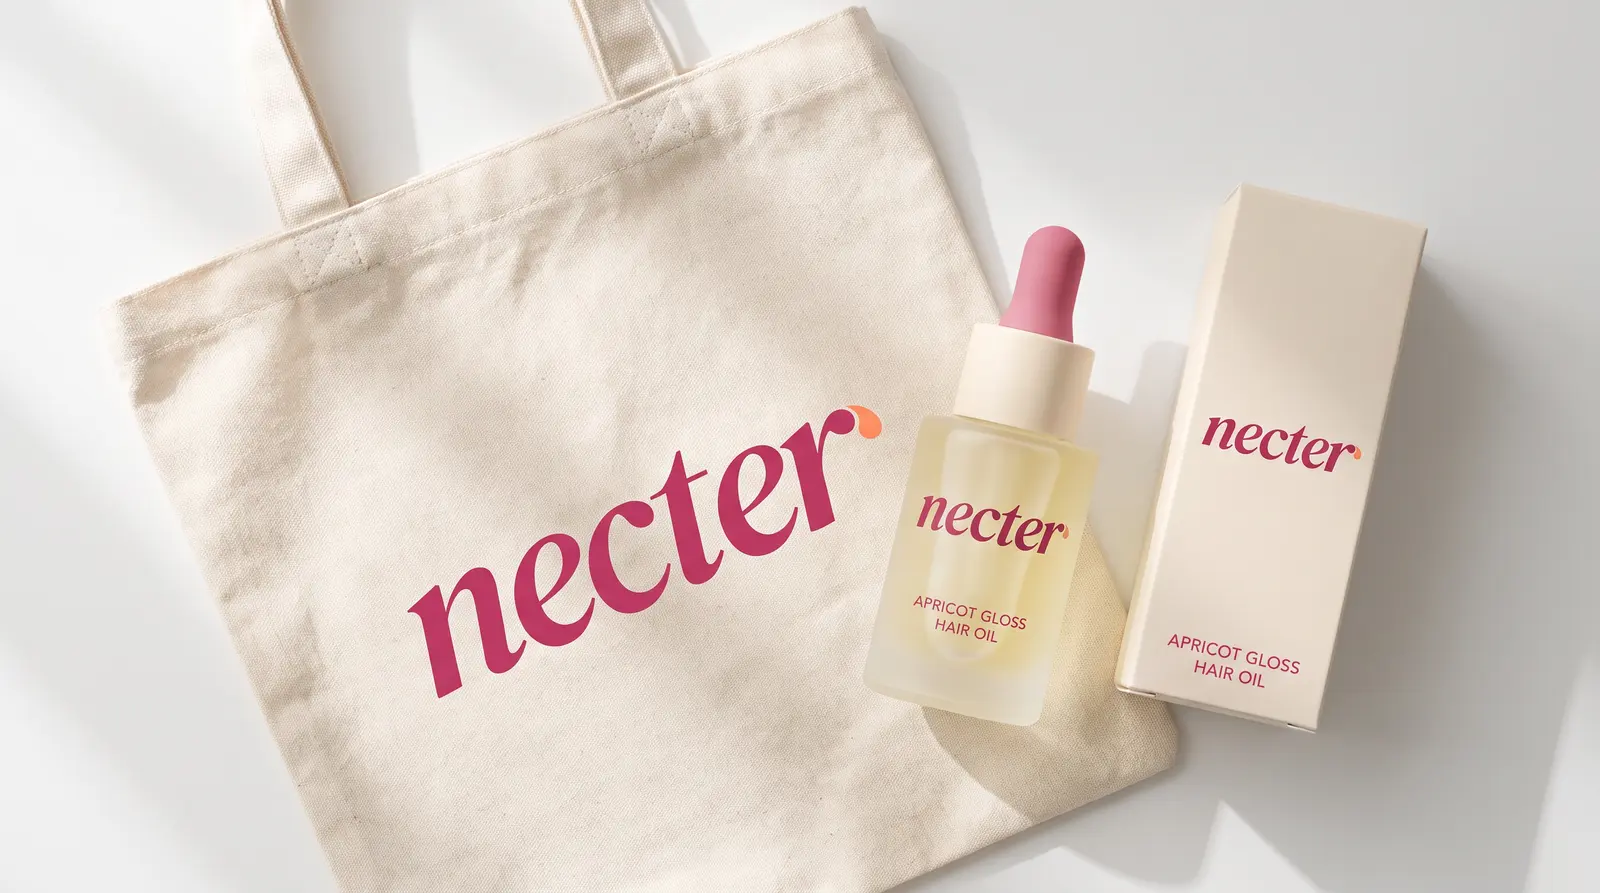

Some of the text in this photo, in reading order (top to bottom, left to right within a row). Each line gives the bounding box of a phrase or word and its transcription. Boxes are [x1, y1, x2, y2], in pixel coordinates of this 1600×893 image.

[1200, 414, 1362, 474] necter
[915, 494, 1069, 555] necter
[407, 405, 882, 700] necter
[912, 595, 1028, 631] APRICOT GLOSS
[934, 618, 998, 643] HAIR OIL
[1167, 633, 1301, 675] APRICOT GLOSS
[1193, 659, 1266, 689] HAIR OIL
